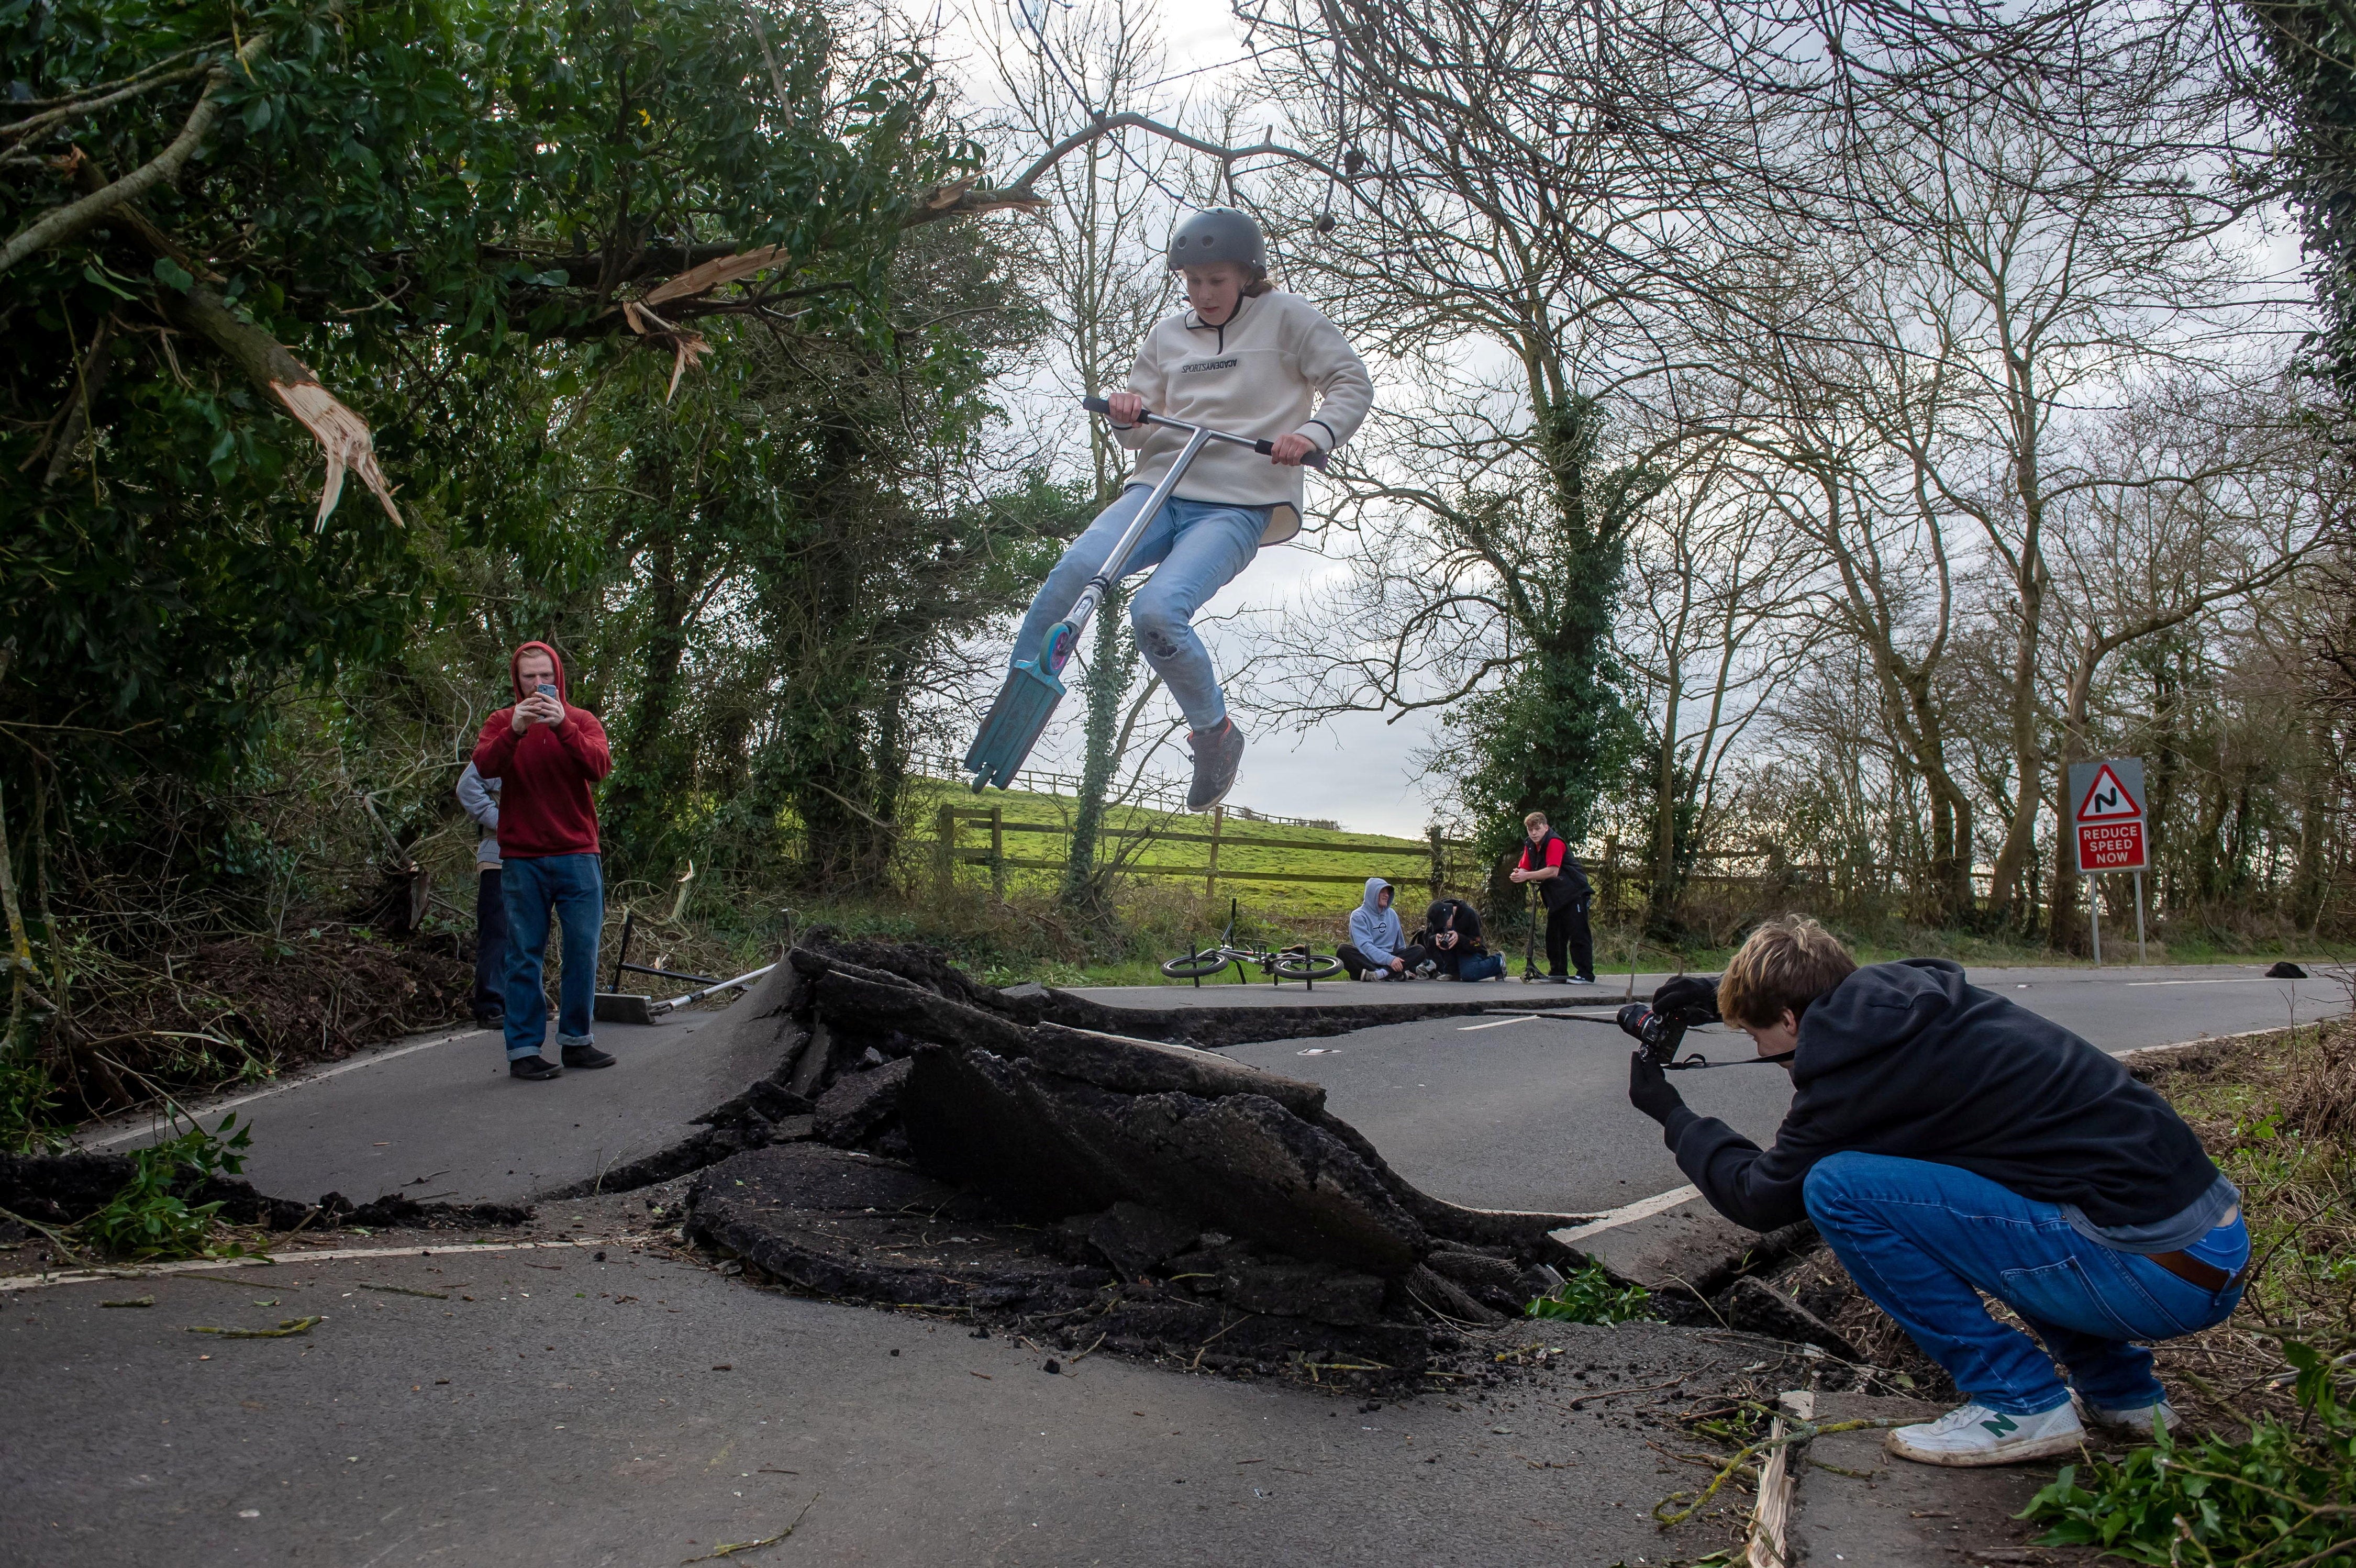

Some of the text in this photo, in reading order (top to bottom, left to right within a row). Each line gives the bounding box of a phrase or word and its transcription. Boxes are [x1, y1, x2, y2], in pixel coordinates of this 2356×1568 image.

[2084, 826, 2137, 840] REDUCE
[2090, 839, 2133, 852] SPEED
[2096, 852, 2128, 864] NOW
[1979, 1412, 2019, 1438] N
